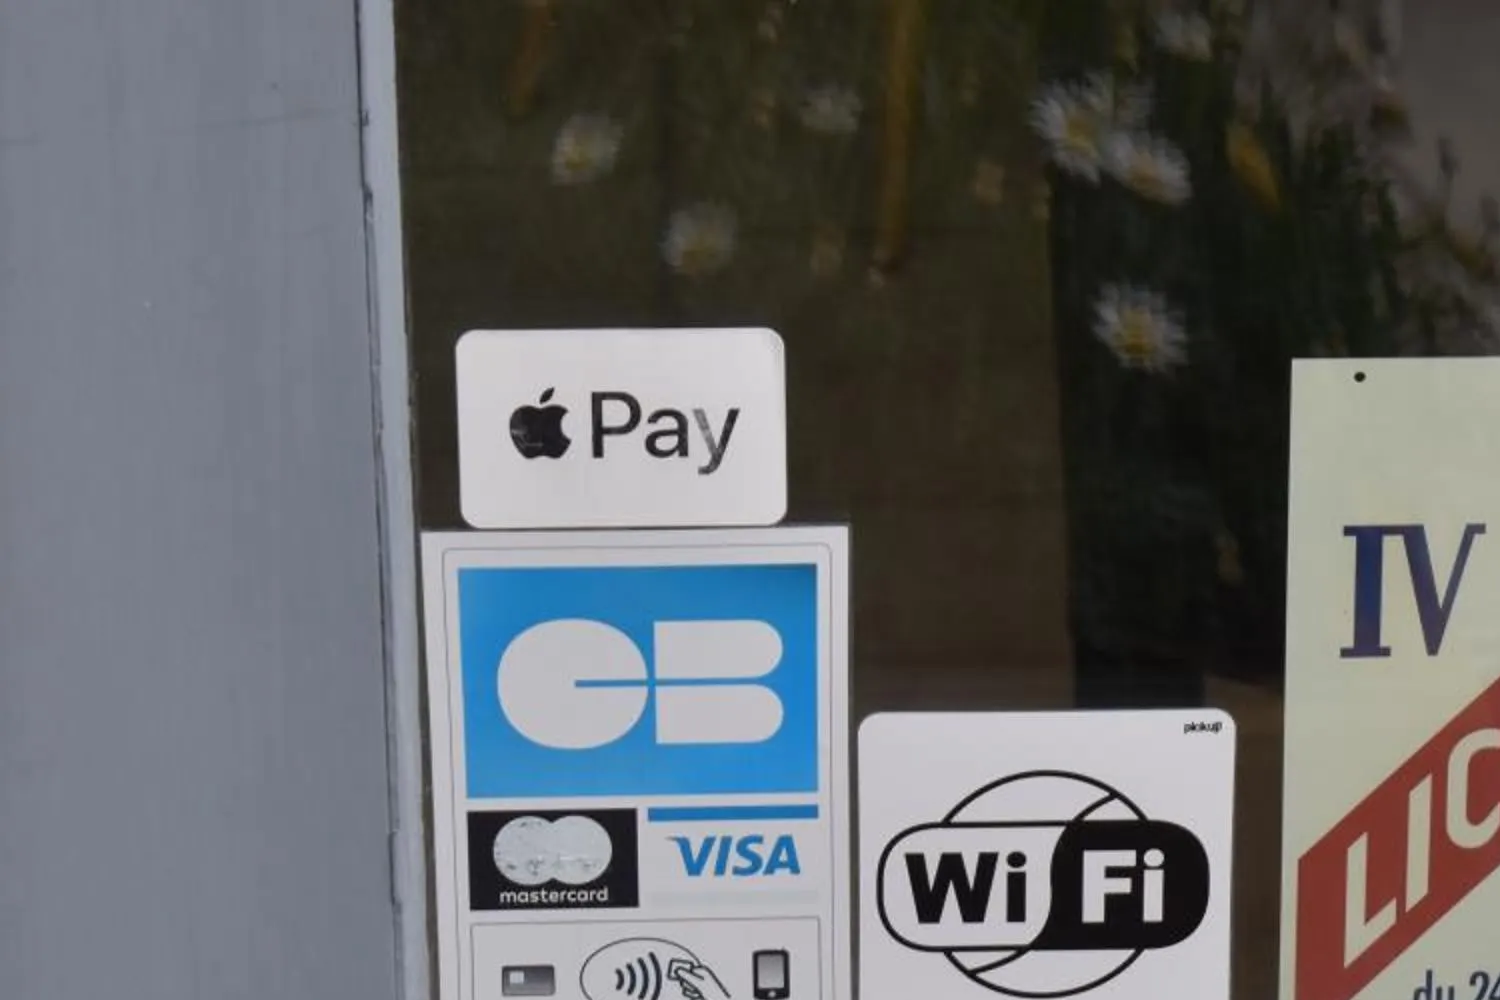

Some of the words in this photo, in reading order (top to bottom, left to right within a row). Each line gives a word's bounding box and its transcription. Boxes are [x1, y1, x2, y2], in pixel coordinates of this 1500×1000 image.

[590, 391, 741, 475] Pay
[1340, 522, 1487, 659] IV
[497, 617, 784, 750] CB
[500, 886, 609, 904] mastercard
[667, 834, 801, 877] VISA
[904, 851, 1028, 924] Wi
[1081, 848, 1165, 924] Fi
